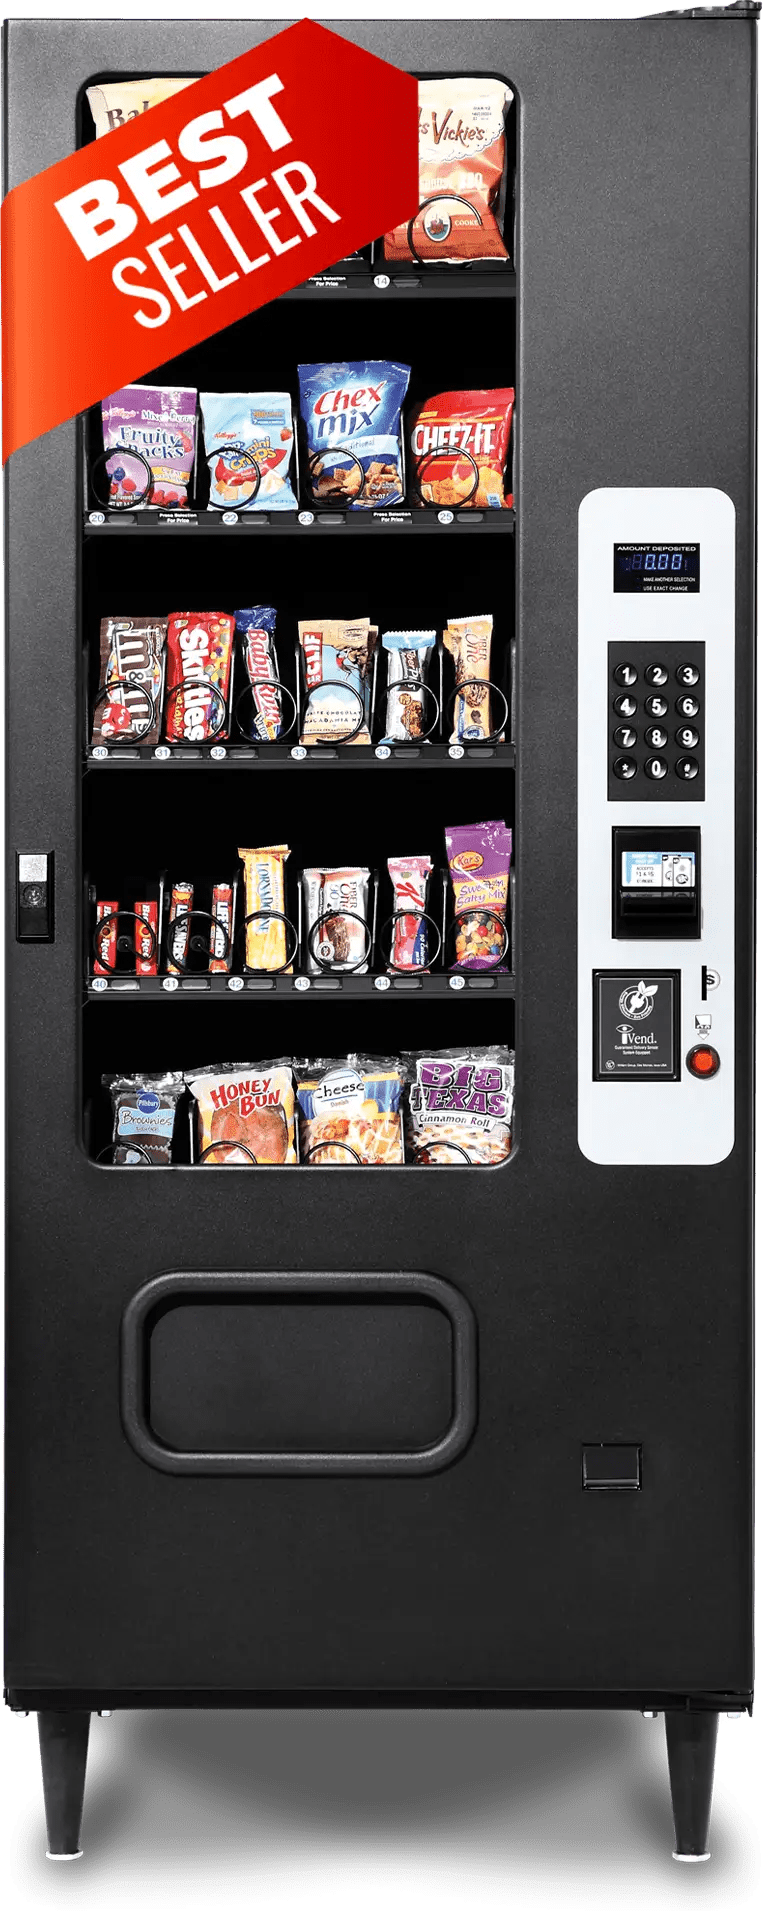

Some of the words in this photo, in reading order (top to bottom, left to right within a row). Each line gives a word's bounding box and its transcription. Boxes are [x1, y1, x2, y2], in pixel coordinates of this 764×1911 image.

[314, 380, 387, 415] Chex
[120, 426, 182, 448] Fruity
[410, 423, 496, 457] CHEEZ-IT
[91, 514, 104, 523] 20
[224, 514, 236, 523] 22
[300, 513, 313, 522] 23
[439, 513, 452, 521] 25
[247, 628, 272, 680] Baby
[622, 667, 630, 683] 1
[652, 667, 662, 683] 2
[682, 667, 693, 683] 3
[620, 698, 630, 714] 4
[651, 698, 662, 714] 5
[682, 698, 693, 714] 6
[621, 729, 631, 745] 7
[651, 729, 662, 745] 8
[682, 729, 693, 745] 9
[94, 748, 107, 757] 30
[157, 748, 168, 757] 31
[211, 748, 224, 757] 32
[292, 747, 306, 756] 33
[376, 747, 389, 756] 34
[450, 747, 463, 755] 35
[651, 760, 661, 776] 0
[396, 881, 425, 908] K
[258, 897, 273, 933] DONE
[93, 979, 106, 988] 40
[165, 979, 176, 988] 41
[229, 979, 242, 988] 42
[296, 979, 309, 988] 43
[376, 979, 389, 987] 44
[451, 978, 463, 986] 45
[419, 1062, 503, 1091] BIG
[210, 1077, 272, 1111] HONEY
[411, 1086, 508, 1118] TEXAS
[239, 1088, 282, 1119] BUN
[121, 1110, 173, 1126] Brownies
[419, 1113, 467, 1125] Cinnamon
[469, 1116, 491, 1128] Roll
